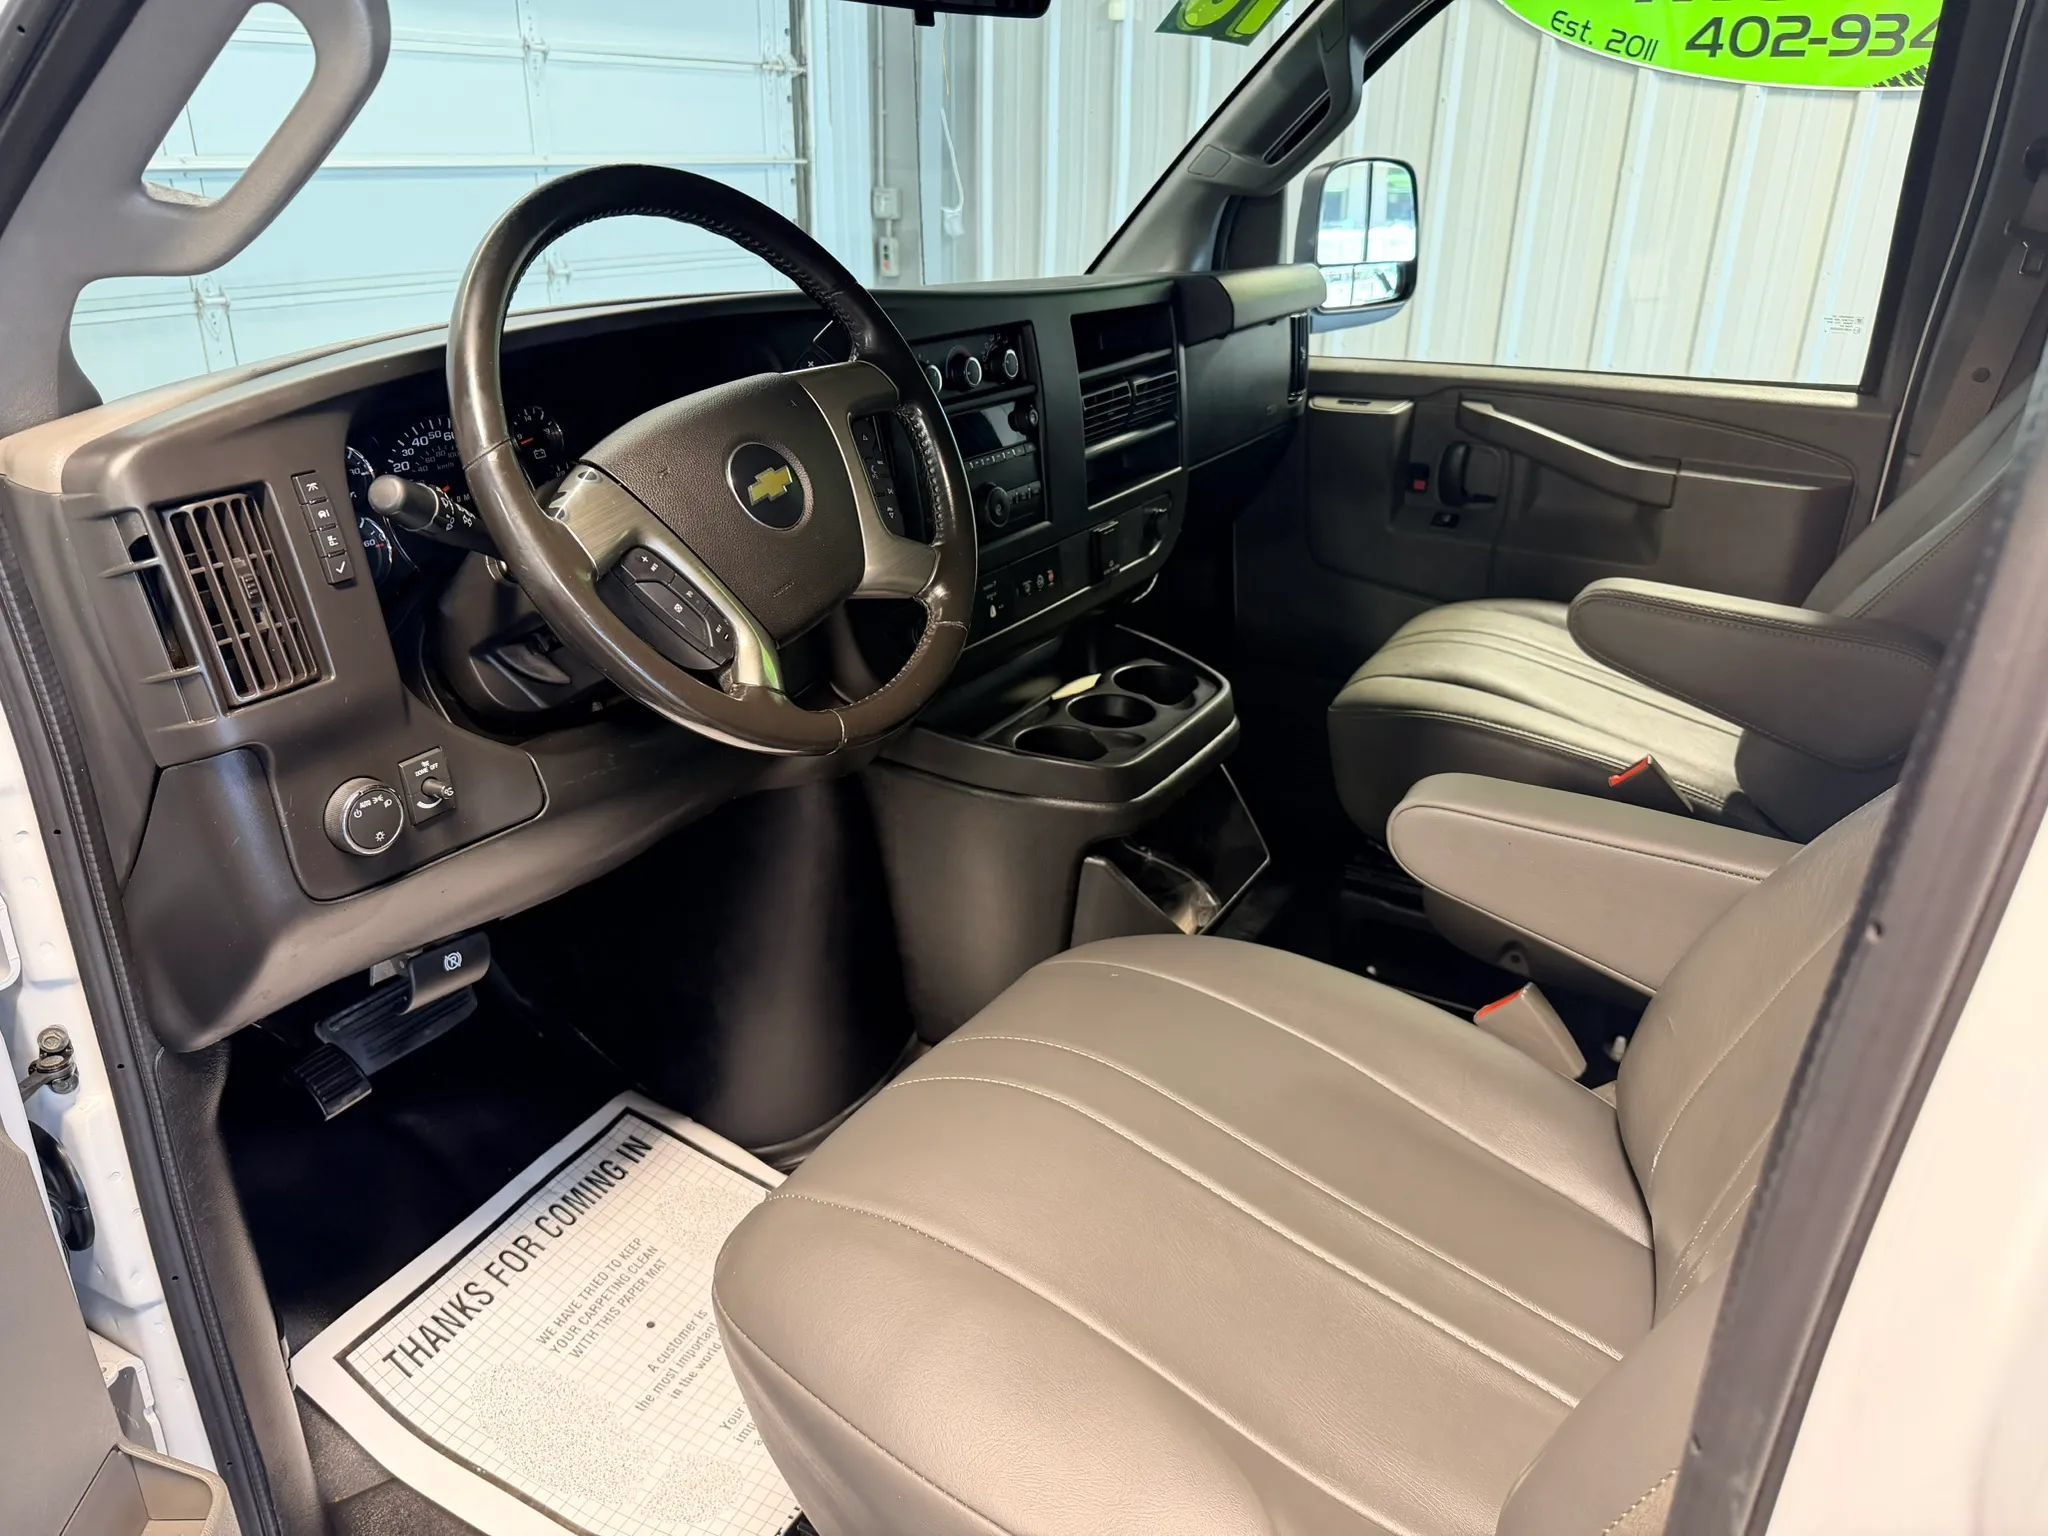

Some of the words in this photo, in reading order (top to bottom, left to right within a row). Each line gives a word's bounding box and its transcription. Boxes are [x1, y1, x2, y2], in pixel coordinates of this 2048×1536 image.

[1550, 9, 1593, 46] Est.
[1604, 29, 1659, 62] 2011
[401, 447, 414, 457] 30
[411, 436, 429, 447] 40
[428, 430, 442, 440] 50
[392, 461, 410, 473] 20
[382, 1281, 495, 1379] THANKS
[484, 1234, 546, 1287] FOR
[534, 1159, 629, 1238] COMING
[616, 1135, 654, 1164] IN
[536, 1326, 556, 1345] WE
[553, 1300, 583, 1328] HAVE
[578, 1271, 609, 1301] TRIED
[605, 1258, 622, 1273] TO
[618, 1237, 642, 1261] KEEP
[551, 1325, 582, 1355] YOUR
[579, 1273, 631, 1326] CARPETING
[627, 1245, 658, 1274] CLEAN
[568, 1329, 599, 1359] WITH
[596, 1305, 621, 1331] THIS
[617, 1278, 649, 1308] PAPER
[645, 1258, 667, 1280] MAT
[635, 1394, 655, 1412] the
[653, 1367, 678, 1396] most
[675, 1322, 718, 1369] important
[647, 1363, 659, 1374] A
[657, 1319, 698, 1365] customer
[694, 1309, 708, 1321] is
[667, 1387, 682, 1400] in
[679, 1371, 698, 1388] the
[696, 1341, 723, 1370] world
[718, 1406, 745, 1431] Your
